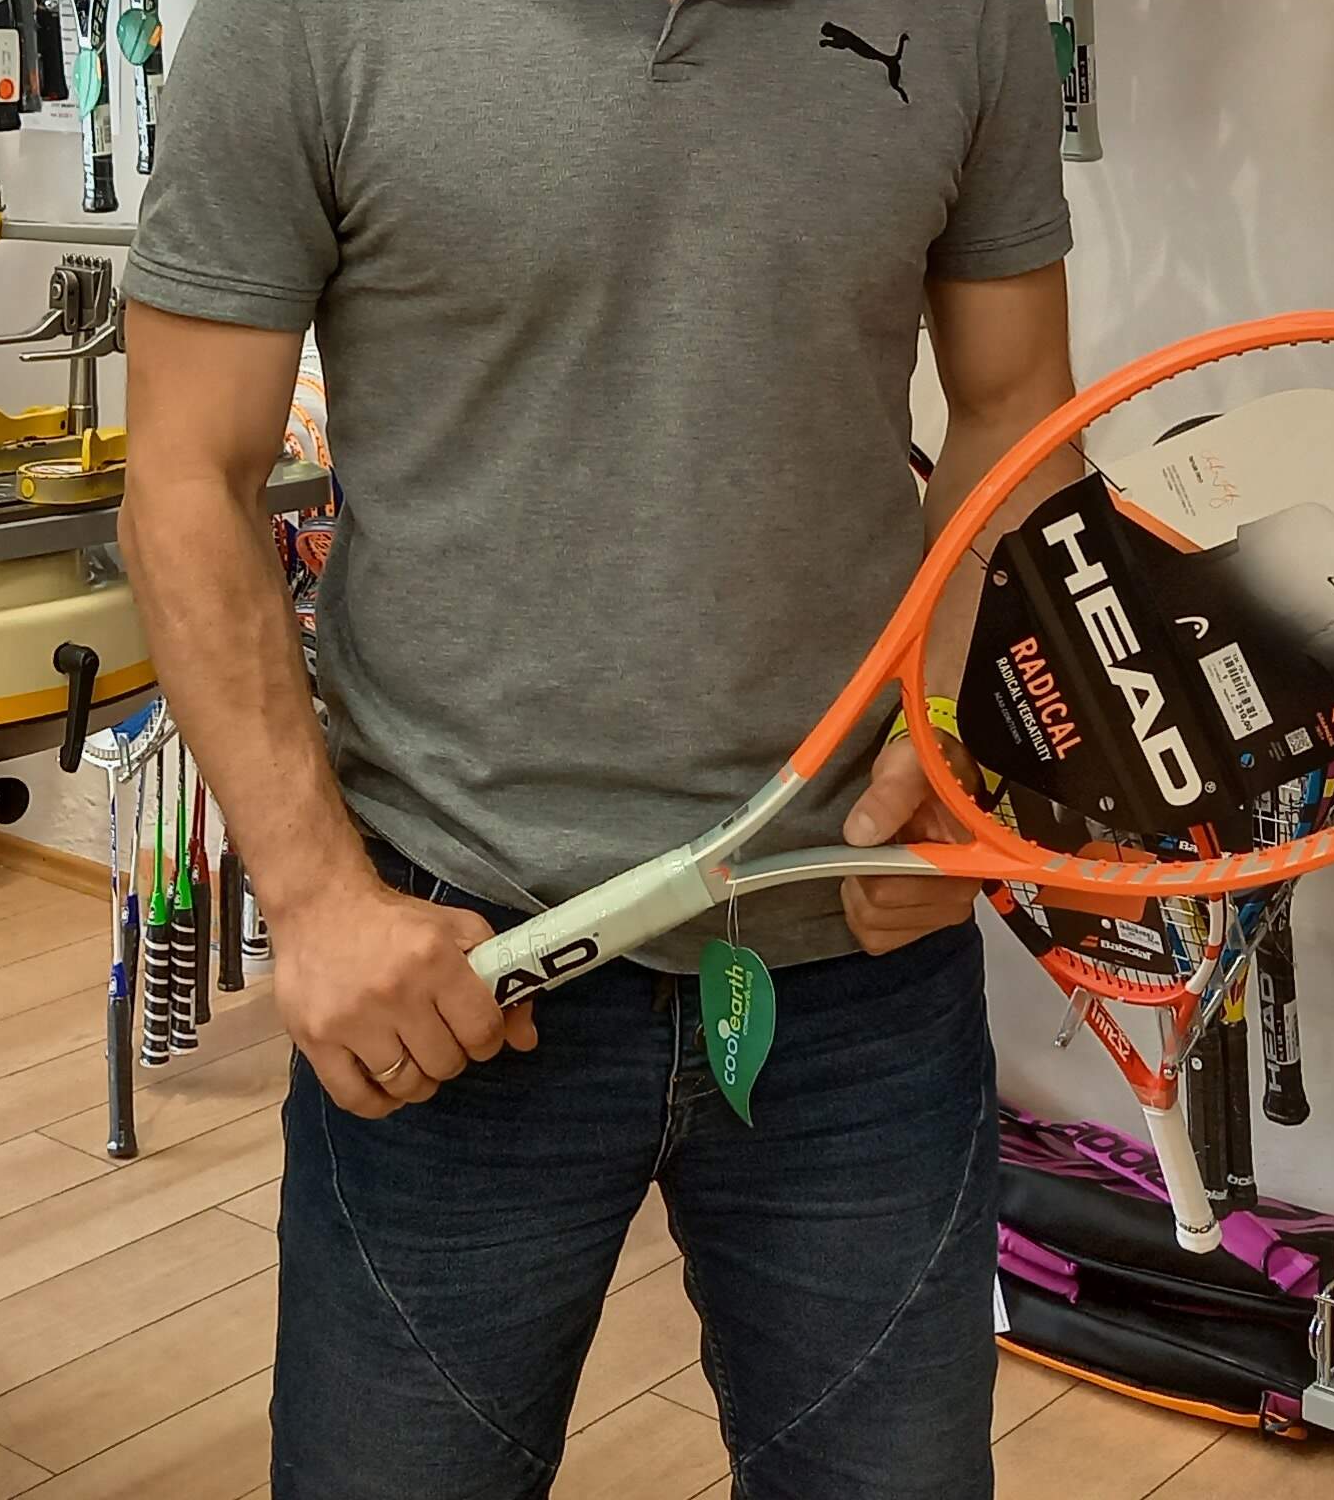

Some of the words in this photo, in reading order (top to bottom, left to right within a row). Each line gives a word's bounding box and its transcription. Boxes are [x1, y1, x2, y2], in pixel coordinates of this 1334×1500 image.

[995, 655, 1019, 703] RADICAL
[1017, 699, 1054, 763] VERSATILITY
[1010, 635, 1084, 761] RADICAL
[1041, 511, 1204, 807] HEAD
[1100, 937, 1154, 961] Babolat
[1259, 971, 1283, 1094] HEAD
